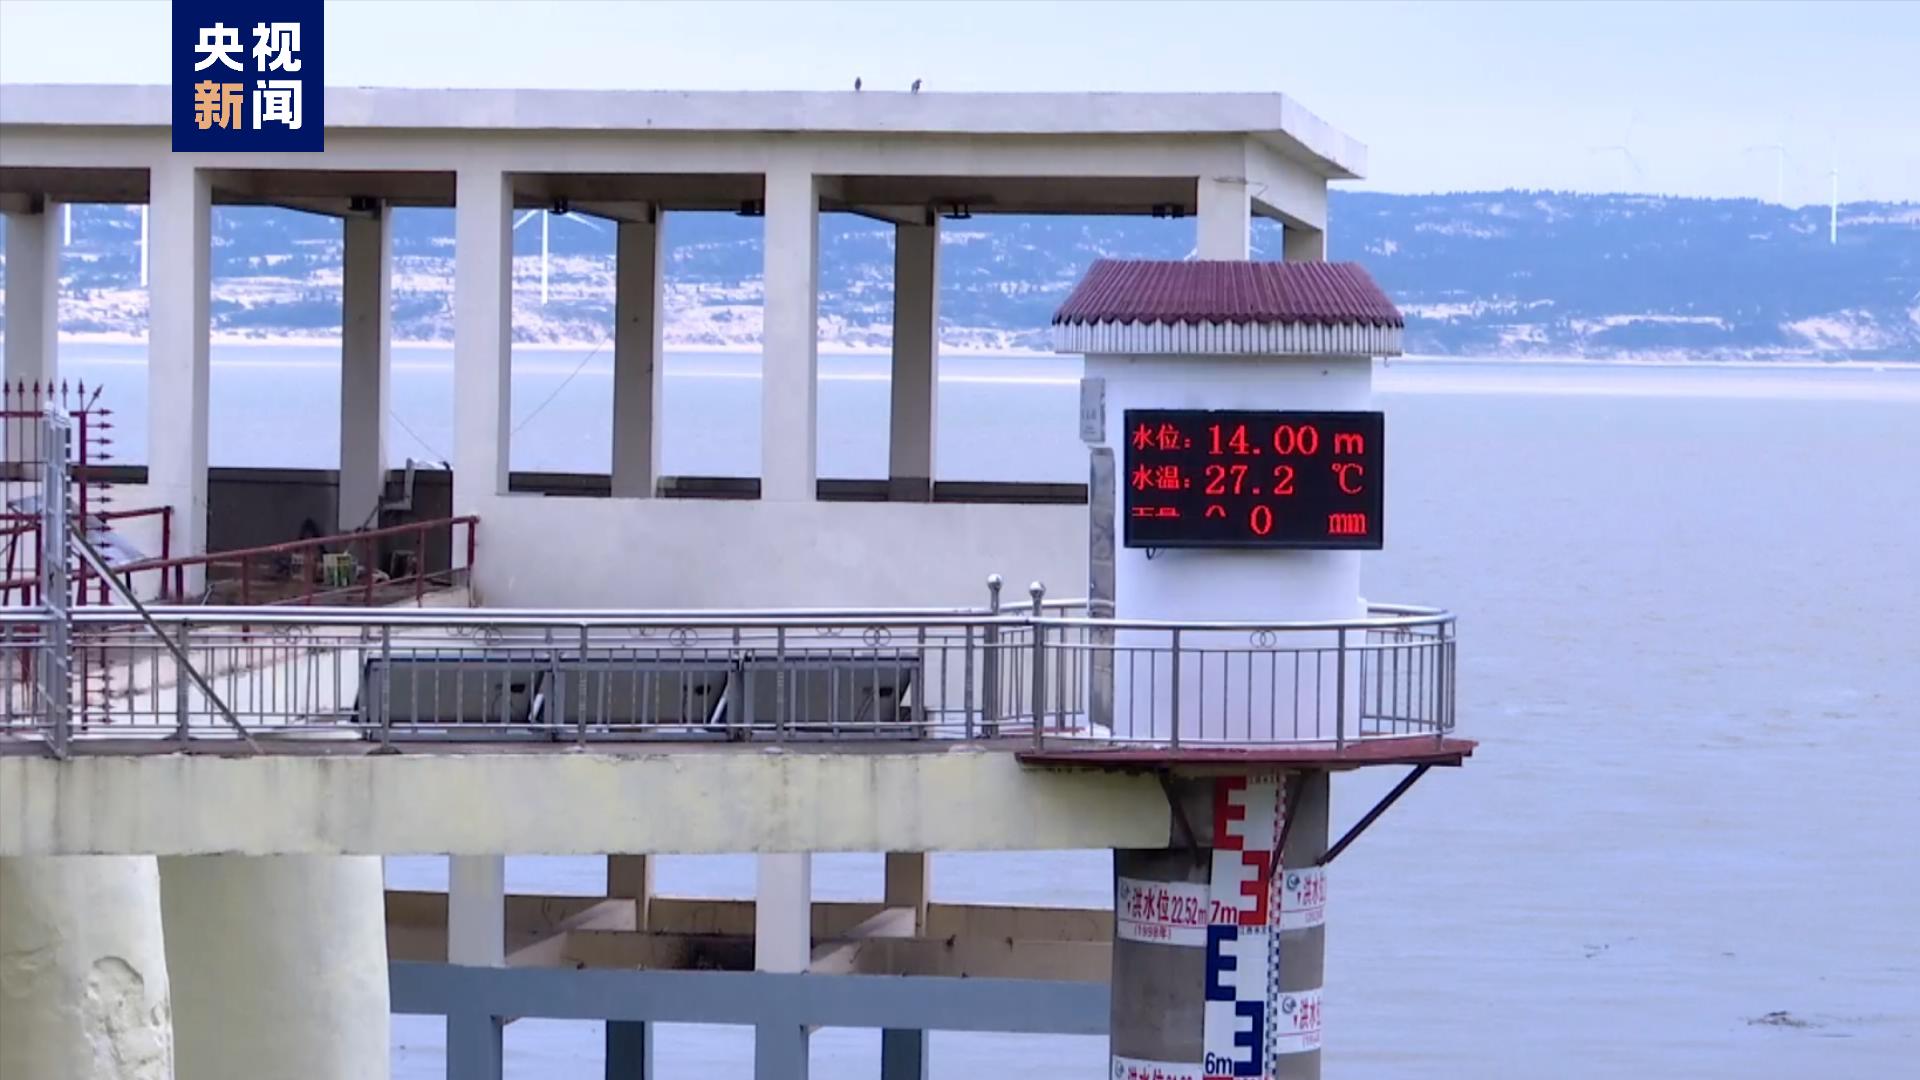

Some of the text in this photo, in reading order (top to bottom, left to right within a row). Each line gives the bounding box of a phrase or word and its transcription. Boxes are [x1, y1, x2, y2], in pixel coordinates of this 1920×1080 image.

[1132, 423, 1364, 455] 水位： 14.00 m
[1132, 465, 1191, 490] 水温：
[1205, 465, 1294, 495] 27.2
[1328, 512, 1367, 534] mm
[1210, 900, 1237, 923] 7m
[1205, 1052, 1233, 1075] 6m
